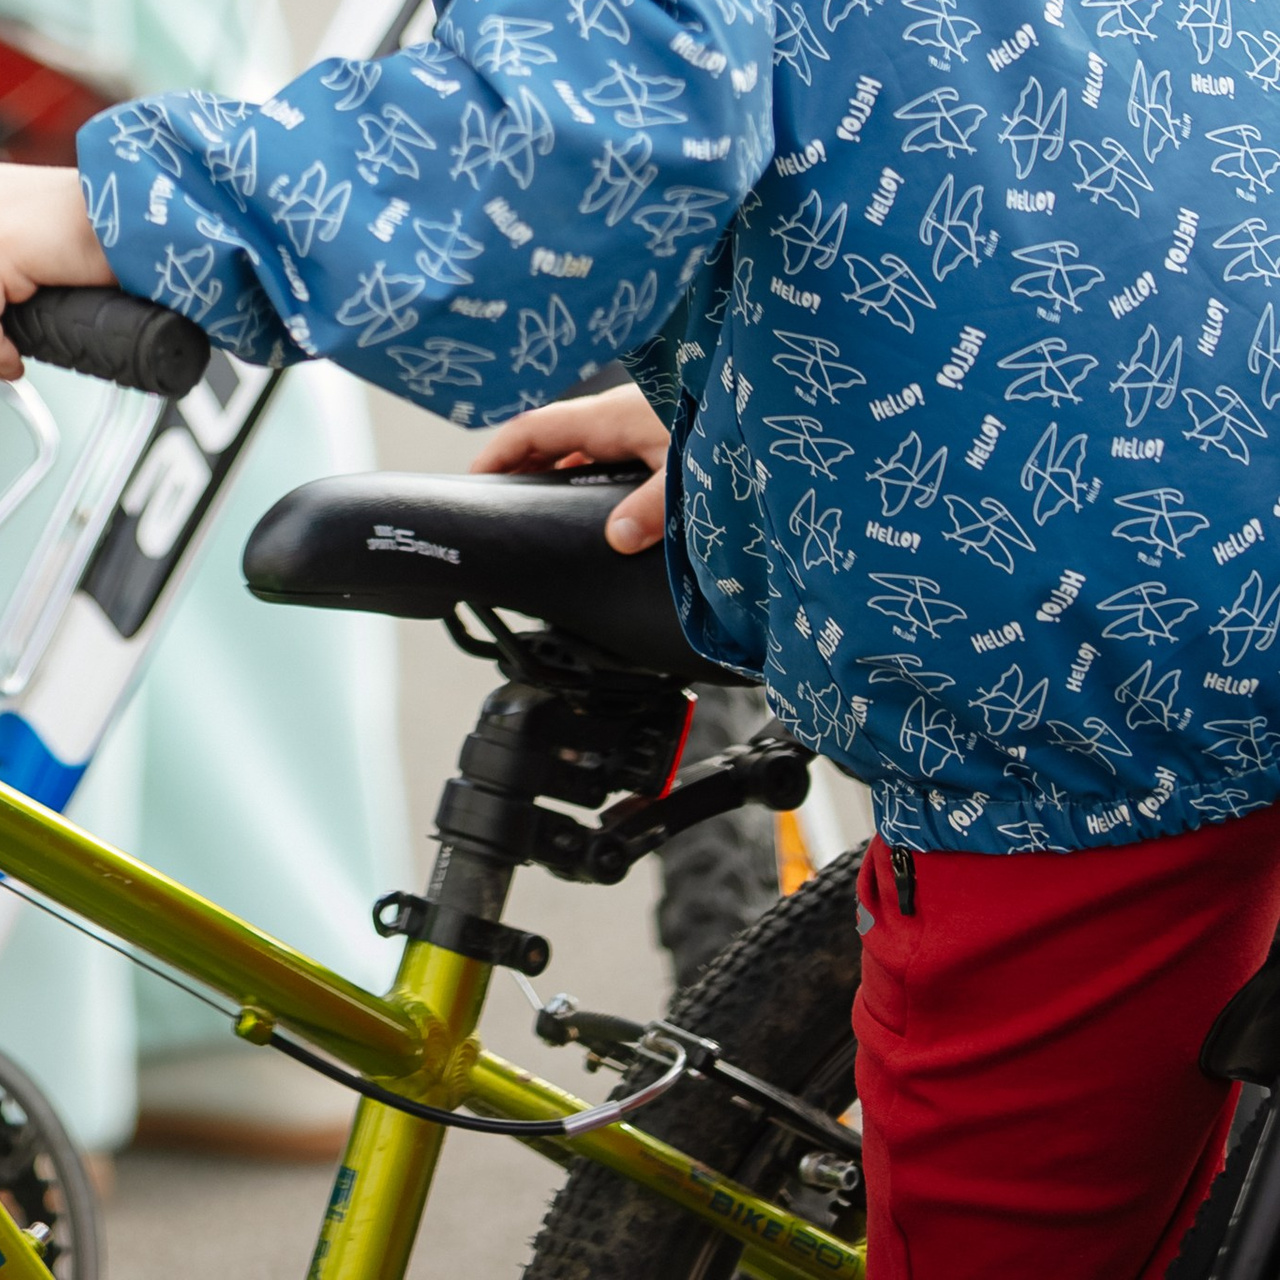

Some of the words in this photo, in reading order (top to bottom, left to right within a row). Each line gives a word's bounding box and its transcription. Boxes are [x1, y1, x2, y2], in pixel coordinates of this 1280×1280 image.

[987, 23, 1039, 72] HELLO!
[1081, 51, 1107, 109] HELLO!
[1191, 73, 1235, 99] HELLO!
[837, 74, 882, 142] HELLO!
[774, 139, 826, 177] HELLO!
[864, 167, 905, 226] HELLO!
[1006, 189, 1056, 216] HELLO!
[1165, 207, 1200, 274] HELLO!
[770, 276, 821, 314] HELLO!
[1109, 271, 1158, 319] HELLO!
[1197, 297, 1229, 357] HELLO!
[936, 325, 987, 390] HELLO!
[869, 383, 926, 422] HELLO!
[964, 414, 1006, 471] HELLO!
[1111, 437, 1165, 463] HELLO!
[865, 521, 921, 553] HELLO!
[1212, 518, 1265, 565] HELLO!
[1036, 569, 1087, 623] HELLO!
[970, 621, 1026, 654] HELLO!
[1066, 642, 1101, 693] HELLO!
[1203, 672, 1259, 697] HELLO!
[1138, 765, 1177, 821] HELLO!
